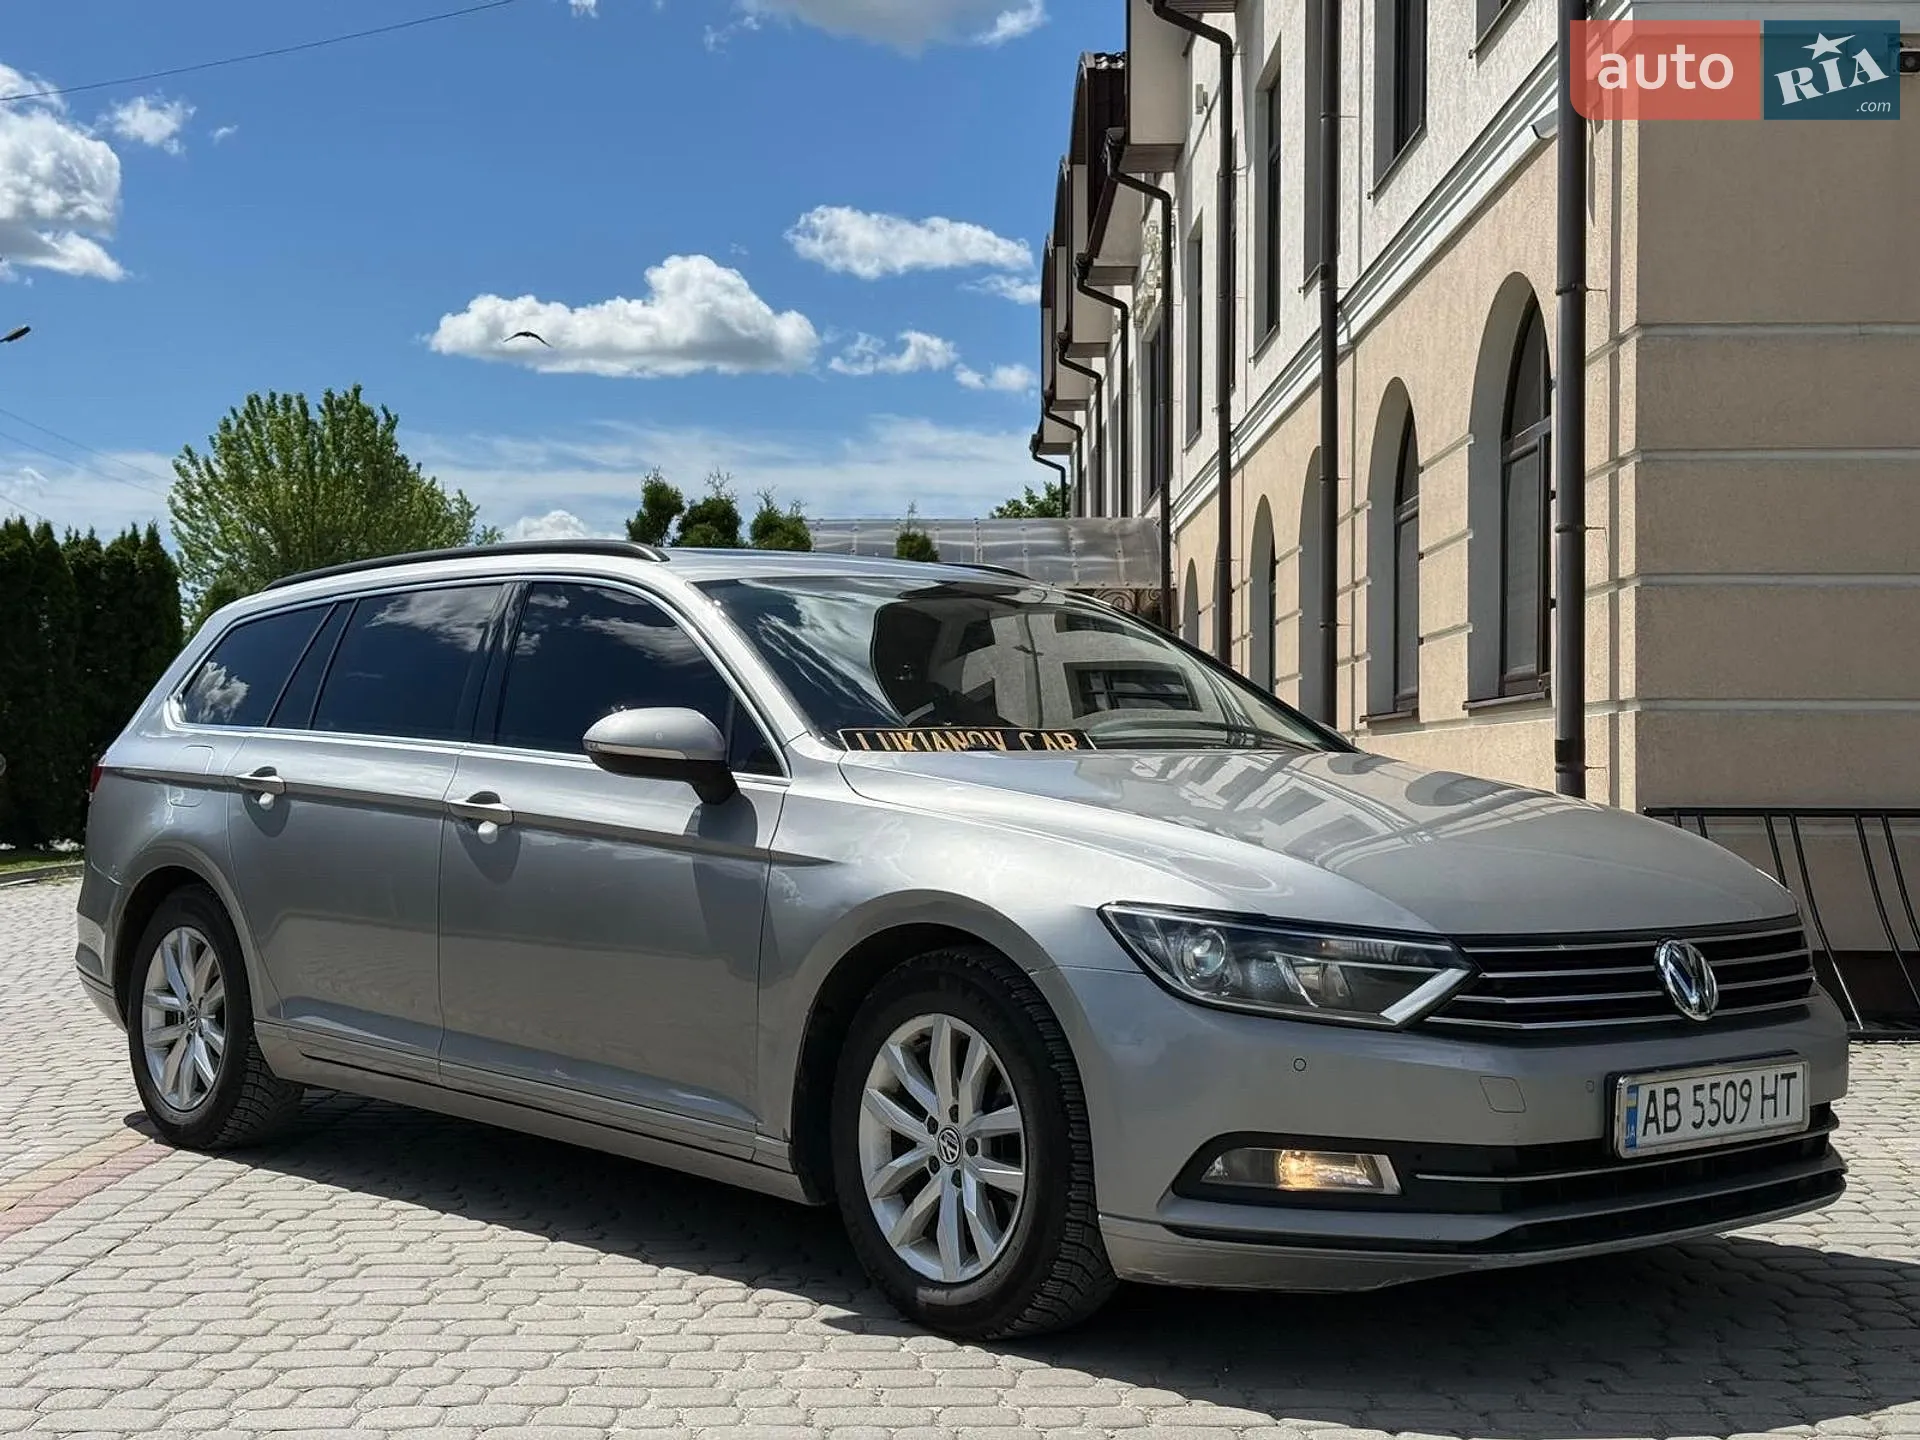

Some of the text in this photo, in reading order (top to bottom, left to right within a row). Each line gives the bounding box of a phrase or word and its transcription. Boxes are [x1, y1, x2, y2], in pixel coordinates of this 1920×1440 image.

[1017, 732, 1079, 751] CAR
[1642, 1071, 1798, 1137] AB 5509 HT
